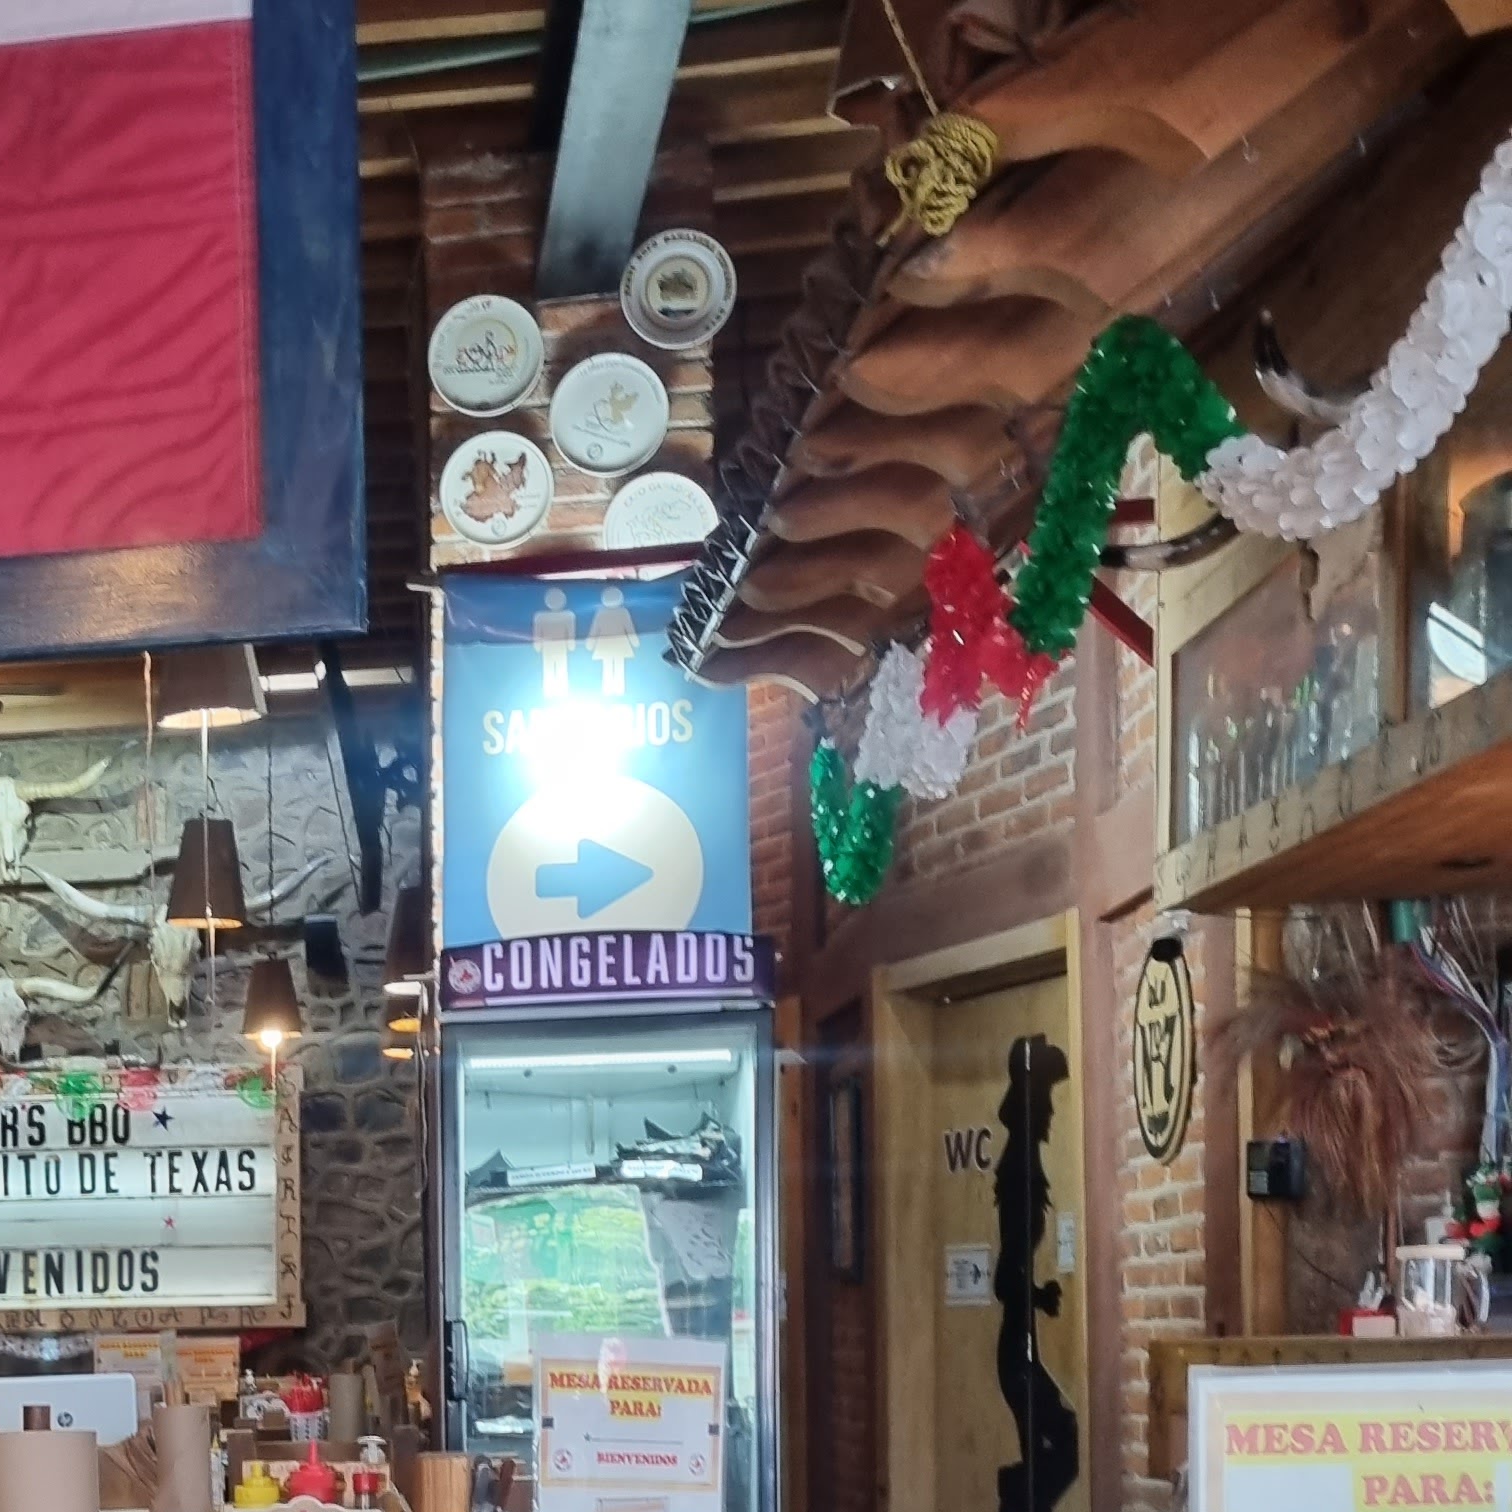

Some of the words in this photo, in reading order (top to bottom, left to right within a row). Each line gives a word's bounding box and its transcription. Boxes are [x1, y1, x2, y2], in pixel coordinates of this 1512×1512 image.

[483, 699, 693, 756] SAIOS
[483, 931, 754, 992] CONGELADOS
[944, 1128, 991, 1172] WC
[78, 1152, 119, 1195] DE
[146, 1149, 256, 1194] TEXAS
[549, 1373, 600, 1390] MESA
[607, 1374, 712, 1396] RESERVADA
[610, 1400, 661, 1417] PARA:
[1226, 1423, 1349, 1455] MESA
[1361, 1472, 1494, 1505] PARA:
